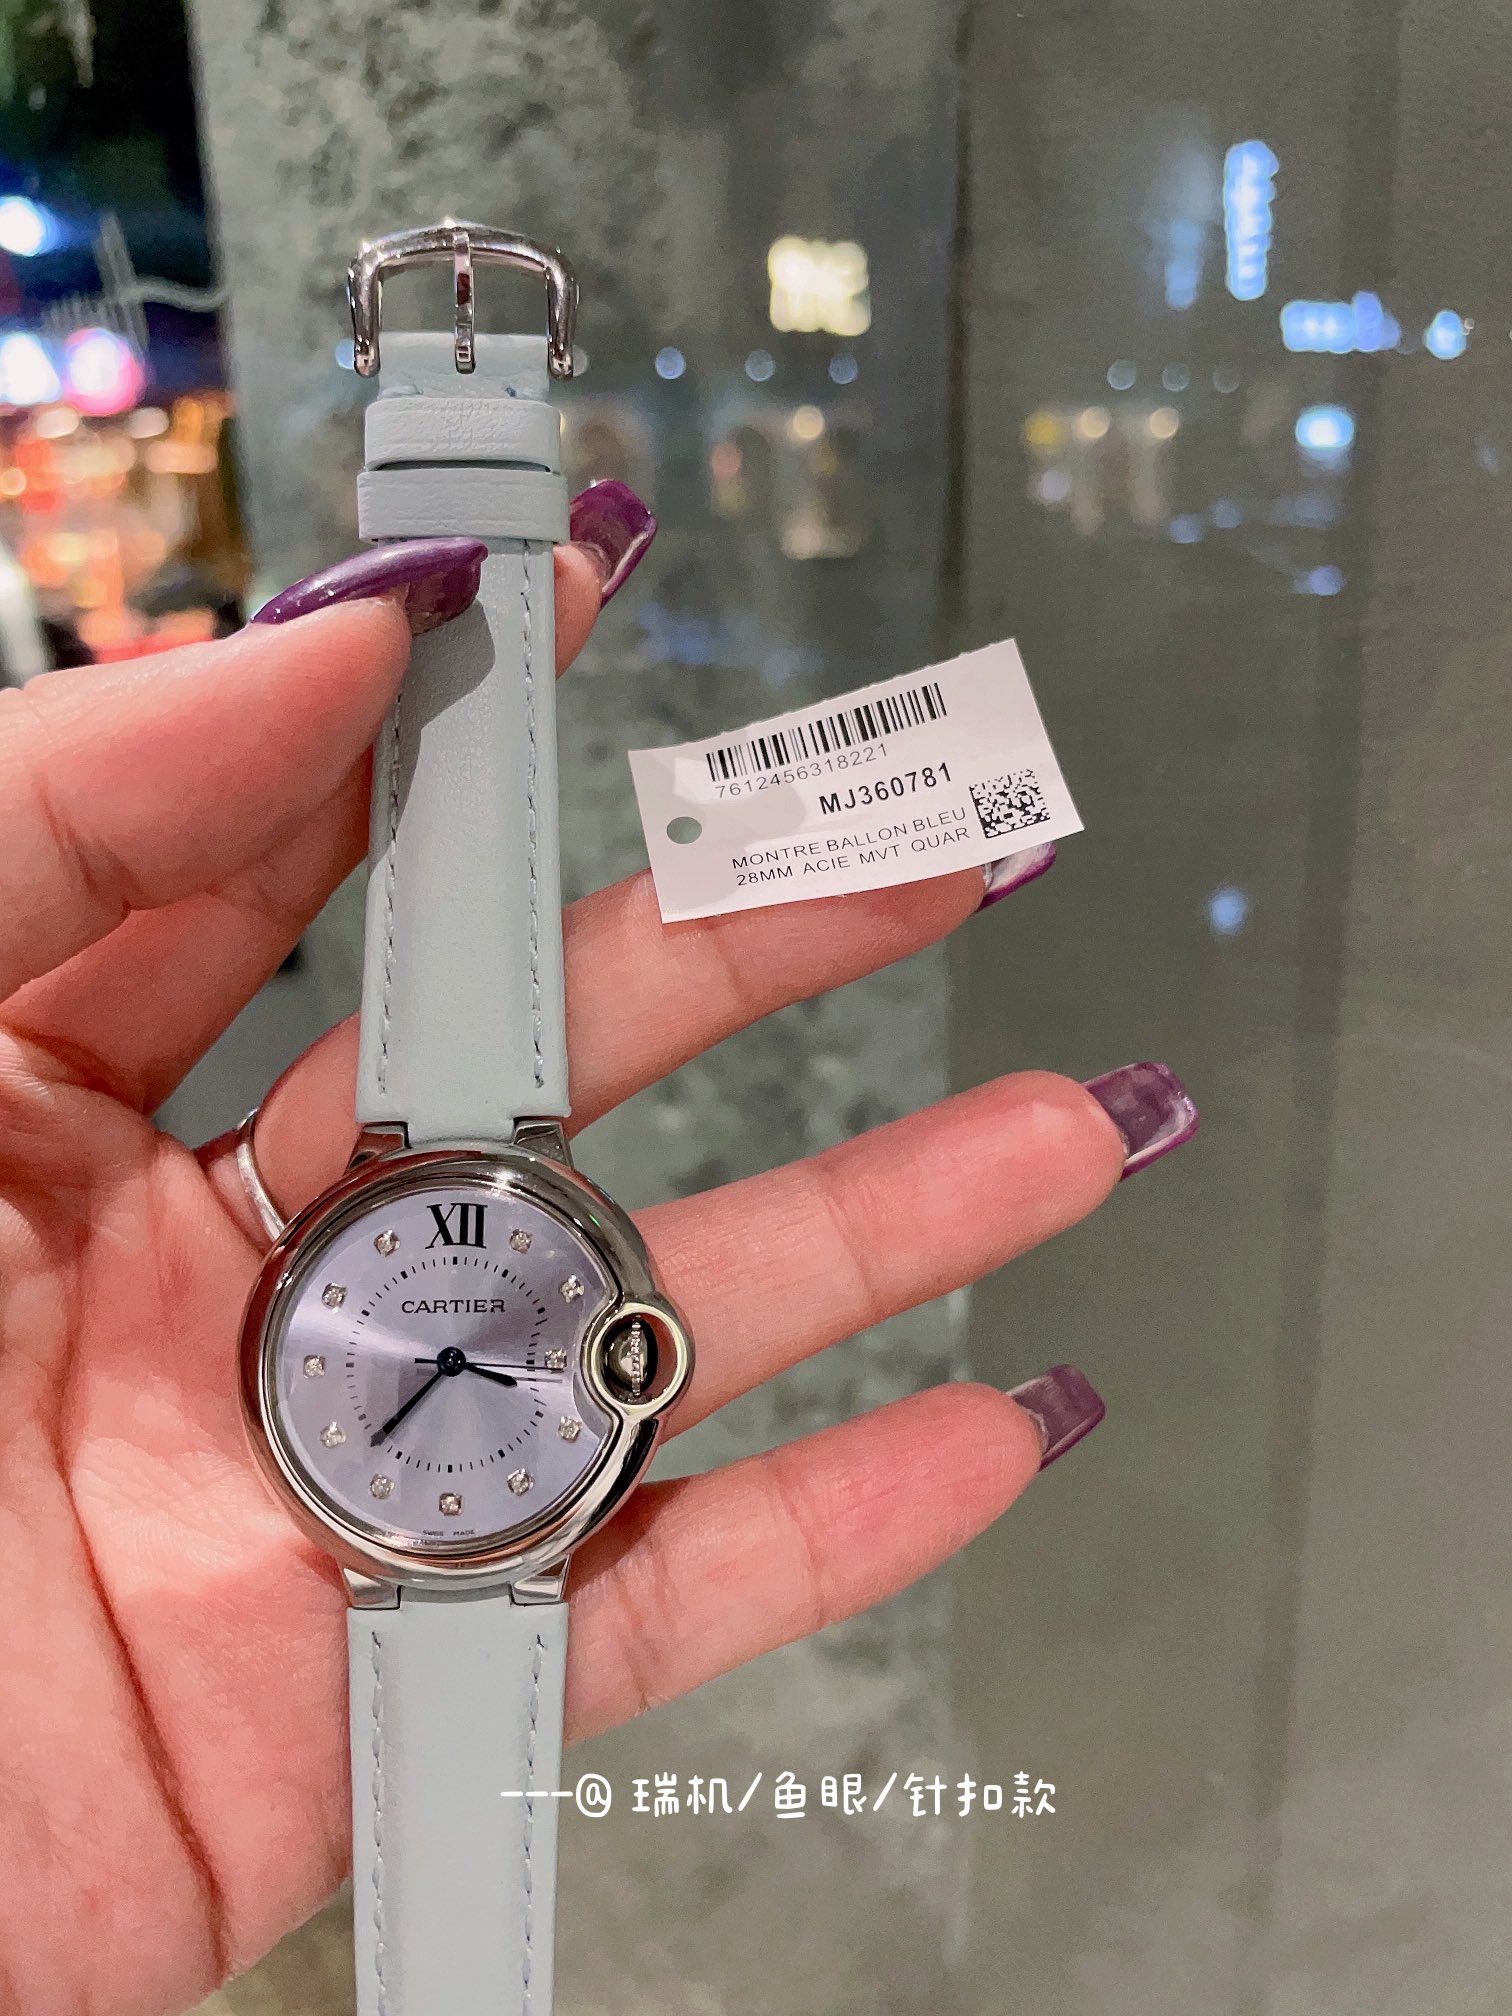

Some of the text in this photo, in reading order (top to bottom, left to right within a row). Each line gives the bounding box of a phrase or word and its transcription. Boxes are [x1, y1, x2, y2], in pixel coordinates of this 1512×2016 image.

[715, 743, 888, 799] 7612456318221
[819, 762, 952, 815] MJ360781
[731, 807, 967, 869] MONTRE BALLON BLEU
[736, 827, 971, 886] 28MM ACIE MVT QUAR
[425, 1203, 488, 1249] XII
[401, 1299, 506, 1314] CARTIER
